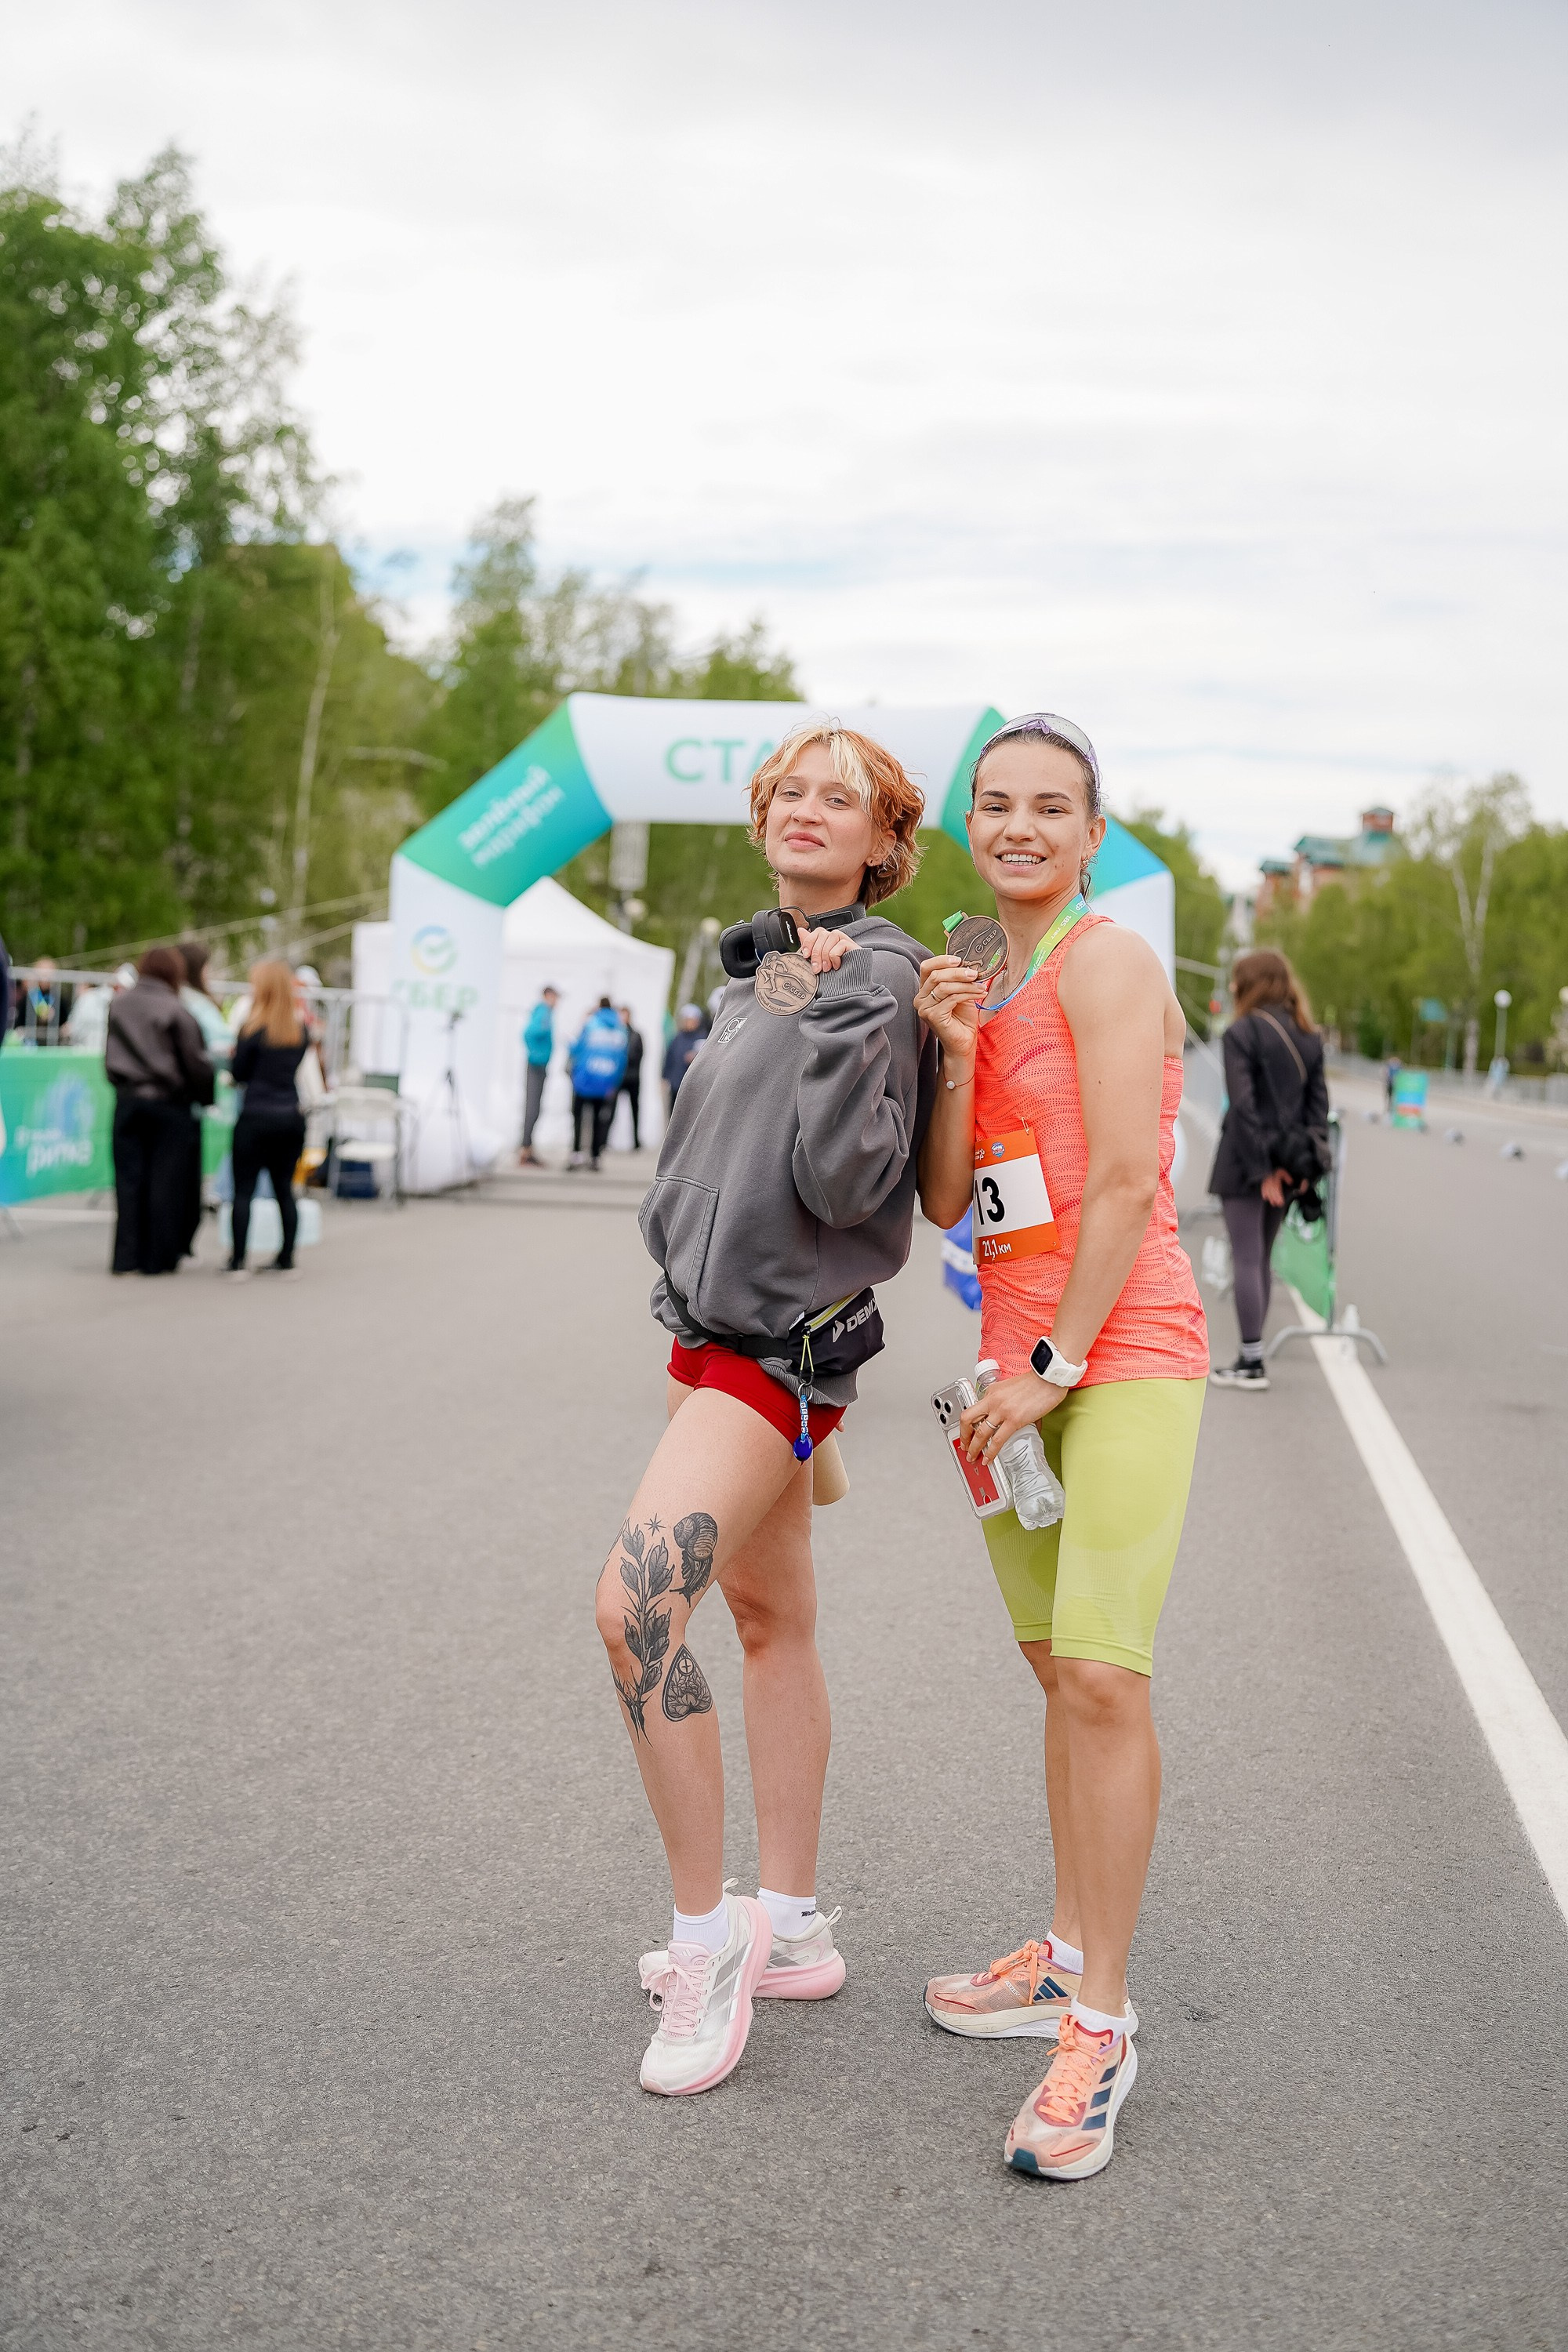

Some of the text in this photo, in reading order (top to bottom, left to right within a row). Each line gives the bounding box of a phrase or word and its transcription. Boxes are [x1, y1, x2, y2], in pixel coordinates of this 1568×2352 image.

[982, 929, 997, 946] СБЕР
[790, 987, 806, 1000] СБЕР
[847, 1298, 879, 1332] DEMIX
